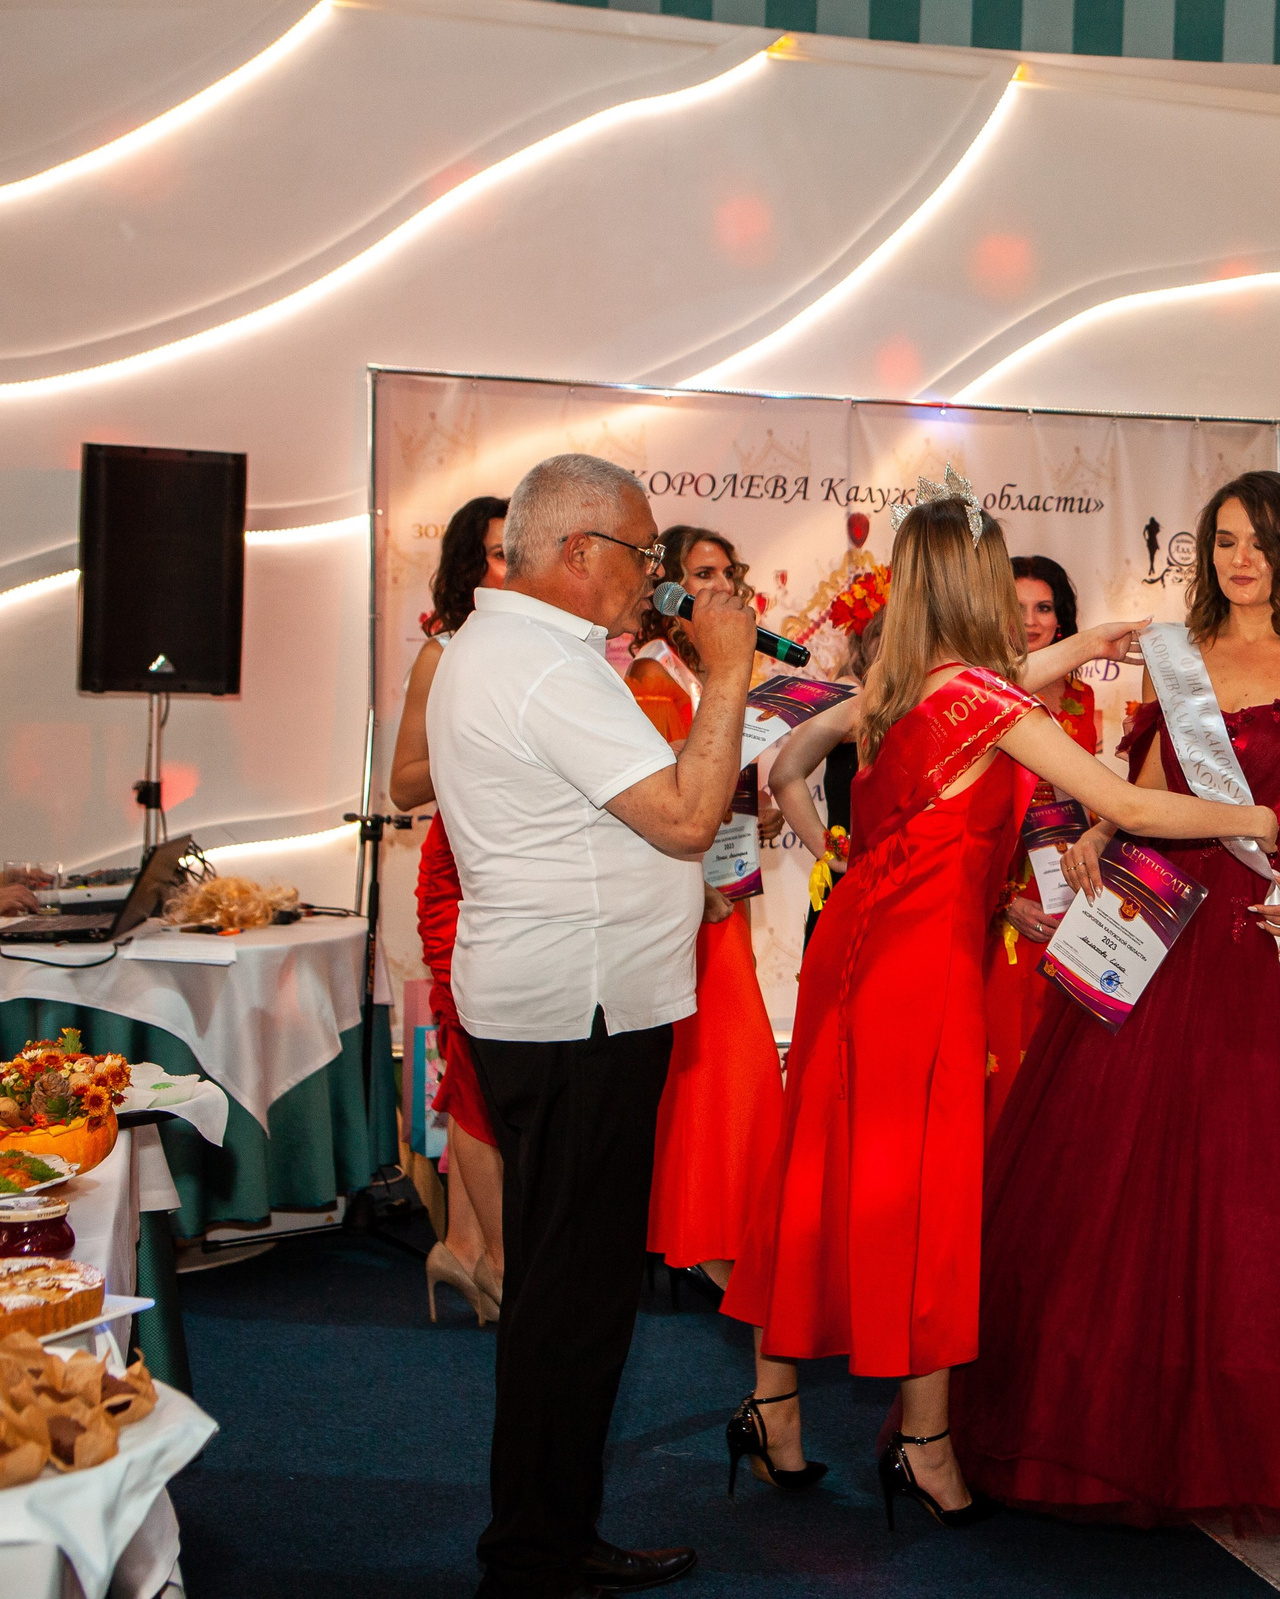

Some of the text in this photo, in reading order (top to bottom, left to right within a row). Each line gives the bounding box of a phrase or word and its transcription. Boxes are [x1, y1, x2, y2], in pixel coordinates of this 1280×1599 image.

[631, 470, 1105, 514] ОРОЛЕВА Калуж области»
[1121, 841, 1193, 900] CERTIFICATE
[1101, 936, 1118, 951] 2023
